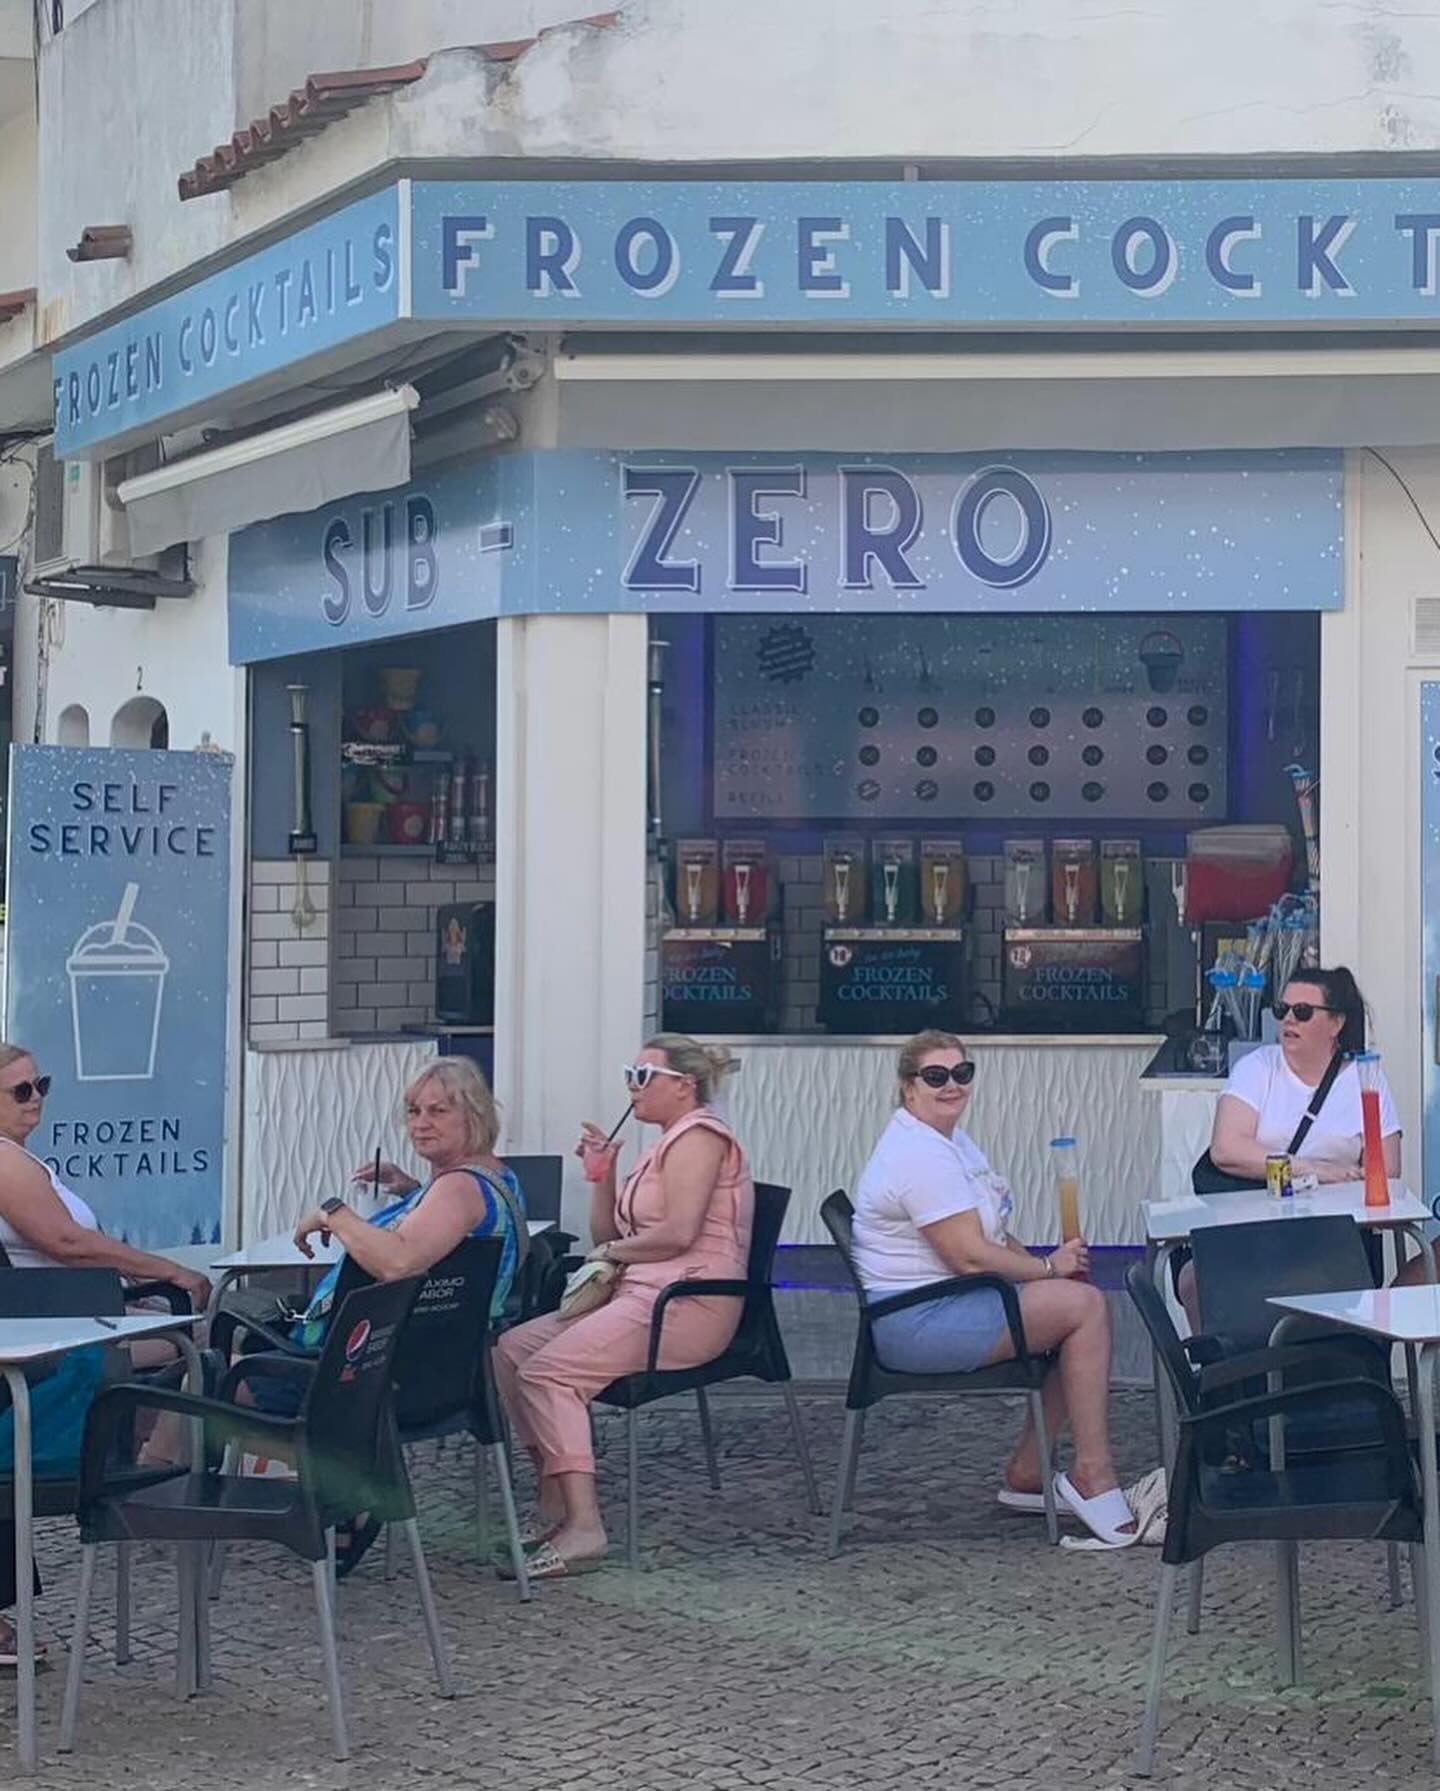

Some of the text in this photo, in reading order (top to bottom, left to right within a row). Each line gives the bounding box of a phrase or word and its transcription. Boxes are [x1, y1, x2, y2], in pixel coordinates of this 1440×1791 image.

[440, 215, 1440, 298] FROZEN COCKT
[53, 222, 394, 434] FROZEN COCKTAILS
[322, 494, 439, 626] SUB
[620, 463, 1053, 594] ZERO
[72, 782, 178, 814] SELF
[29, 824, 215, 856] SERVICE
[853, 967, 933, 982] FROZEN
[1035, 967, 1113, 982] FROZEN
[663, 984, 752, 1001] CKTAILS
[837, 984, 948, 1001] COCKTAILS
[1018, 984, 1129, 1001] COCKTAILS
[53, 1118, 180, 1147] FROZEN
[43, 1150, 208, 1178] OCKTAILS
[419, 1287, 455, 1300] ABOR
[423, 1276, 466, 1289] AXIMO
